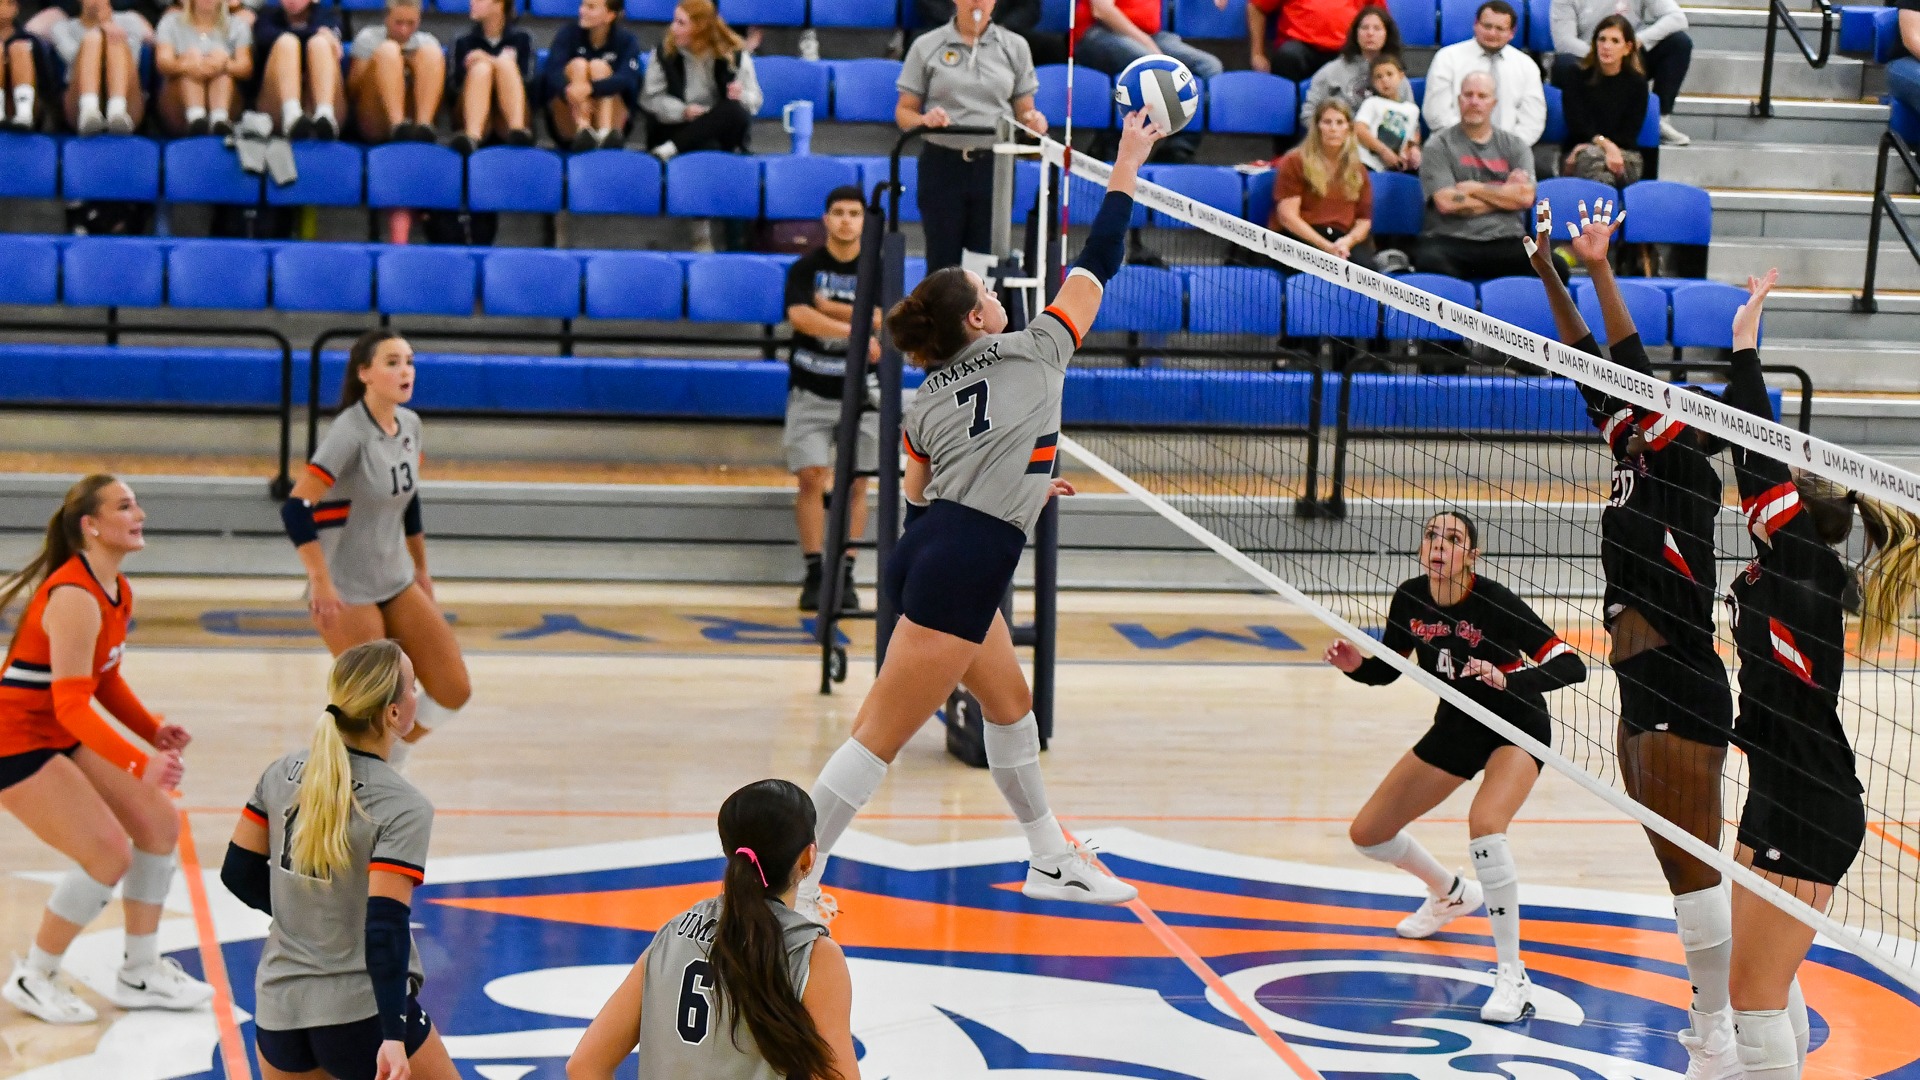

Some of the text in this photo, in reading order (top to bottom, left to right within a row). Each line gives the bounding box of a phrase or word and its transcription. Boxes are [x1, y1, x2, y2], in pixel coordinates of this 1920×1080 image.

[1273, 239, 1339, 276] UMARY MARAUDERS
[1356, 271, 1431, 312] UMARY MARAUDERS
[1450, 308, 1535, 353] UMARY MARAUDERS
[1557, 349, 1654, 399] UMARY MARAUDERS
[953, 378, 992, 439] 7
[1680, 396, 1792, 452] UMARY MARAUDERS
[391, 462, 413, 496] 13
[1822, 449, 1865, 480] UMARY
[1409, 618, 1452, 644] Magic
[1436, 648, 1455, 680] 4
[676, 958, 715, 1046] 6
